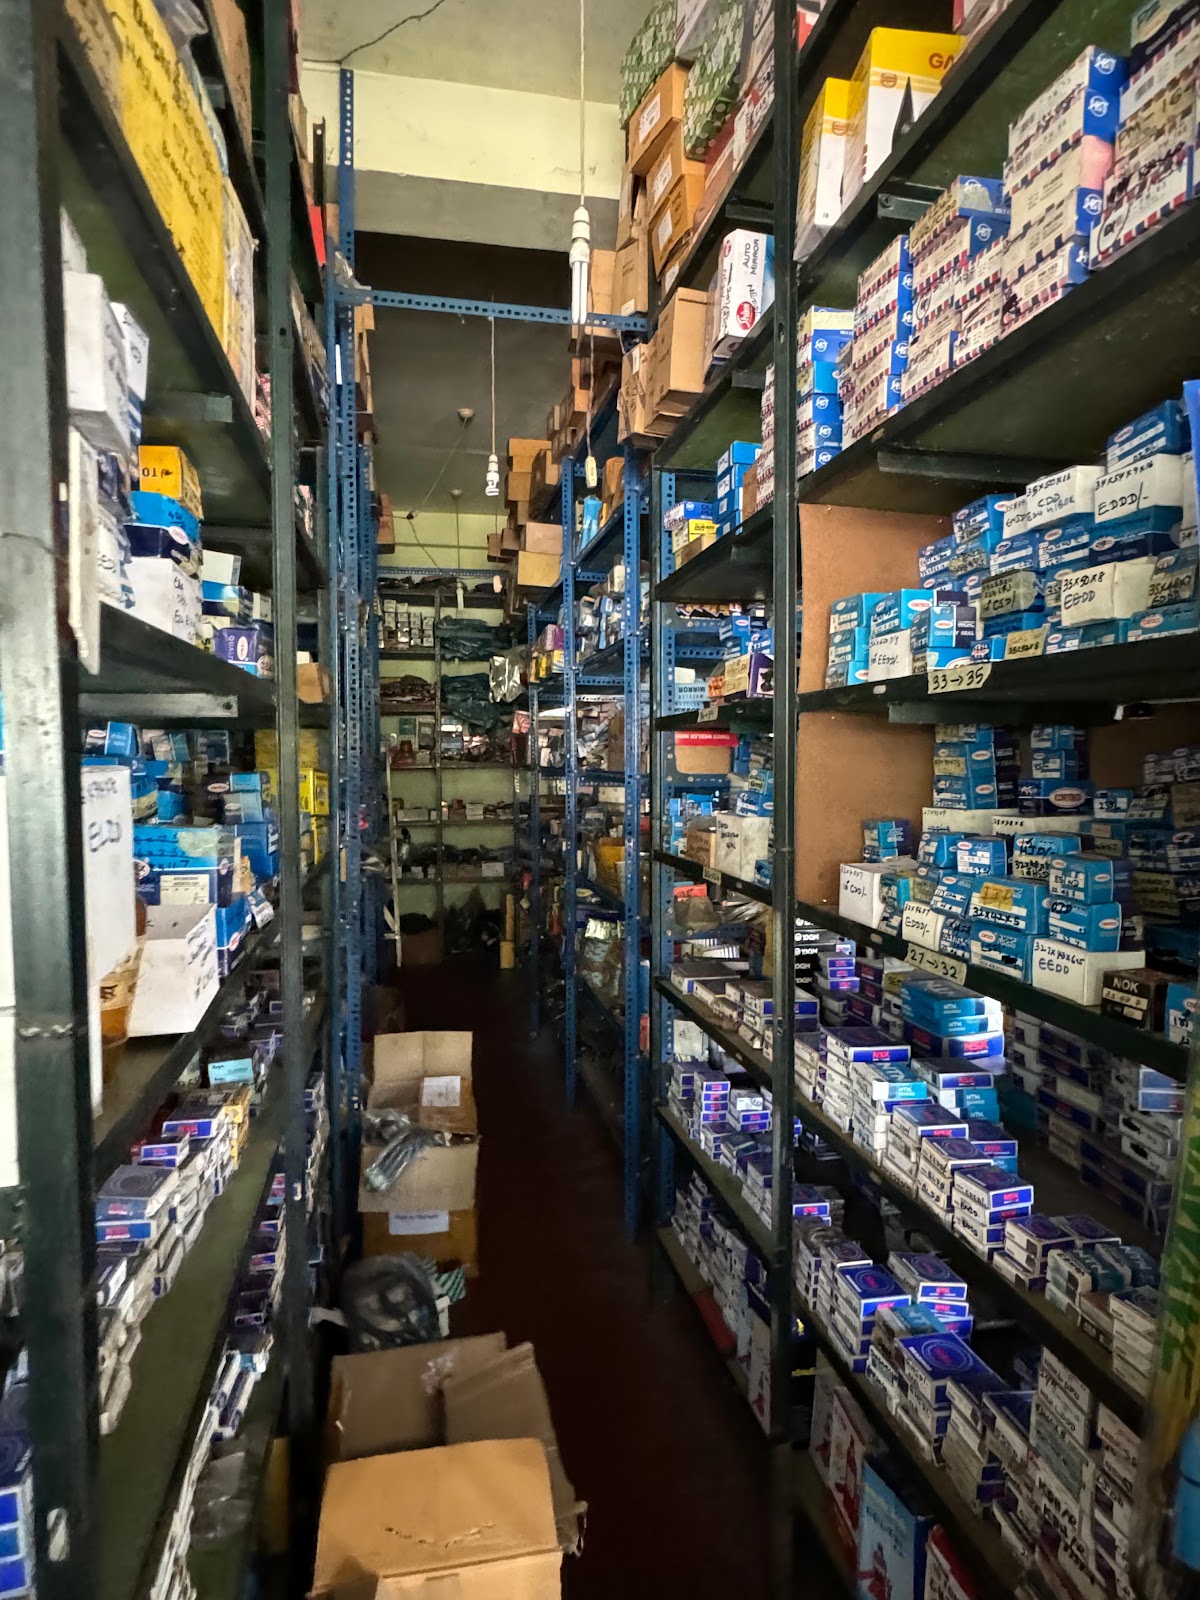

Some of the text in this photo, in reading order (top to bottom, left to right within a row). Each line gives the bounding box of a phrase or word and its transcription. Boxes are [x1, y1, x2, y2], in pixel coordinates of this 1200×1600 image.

[742, 242, 751, 269] AUTO
[750, 238, 760, 275] MIRROR
[932, 666, 984, 690] 33 35
[909, 949, 926, 964] 27
[940, 959, 959, 980] 32
[1113, 976, 1140, 994] NOK
[873, 1051, 890, 1059] NSK
